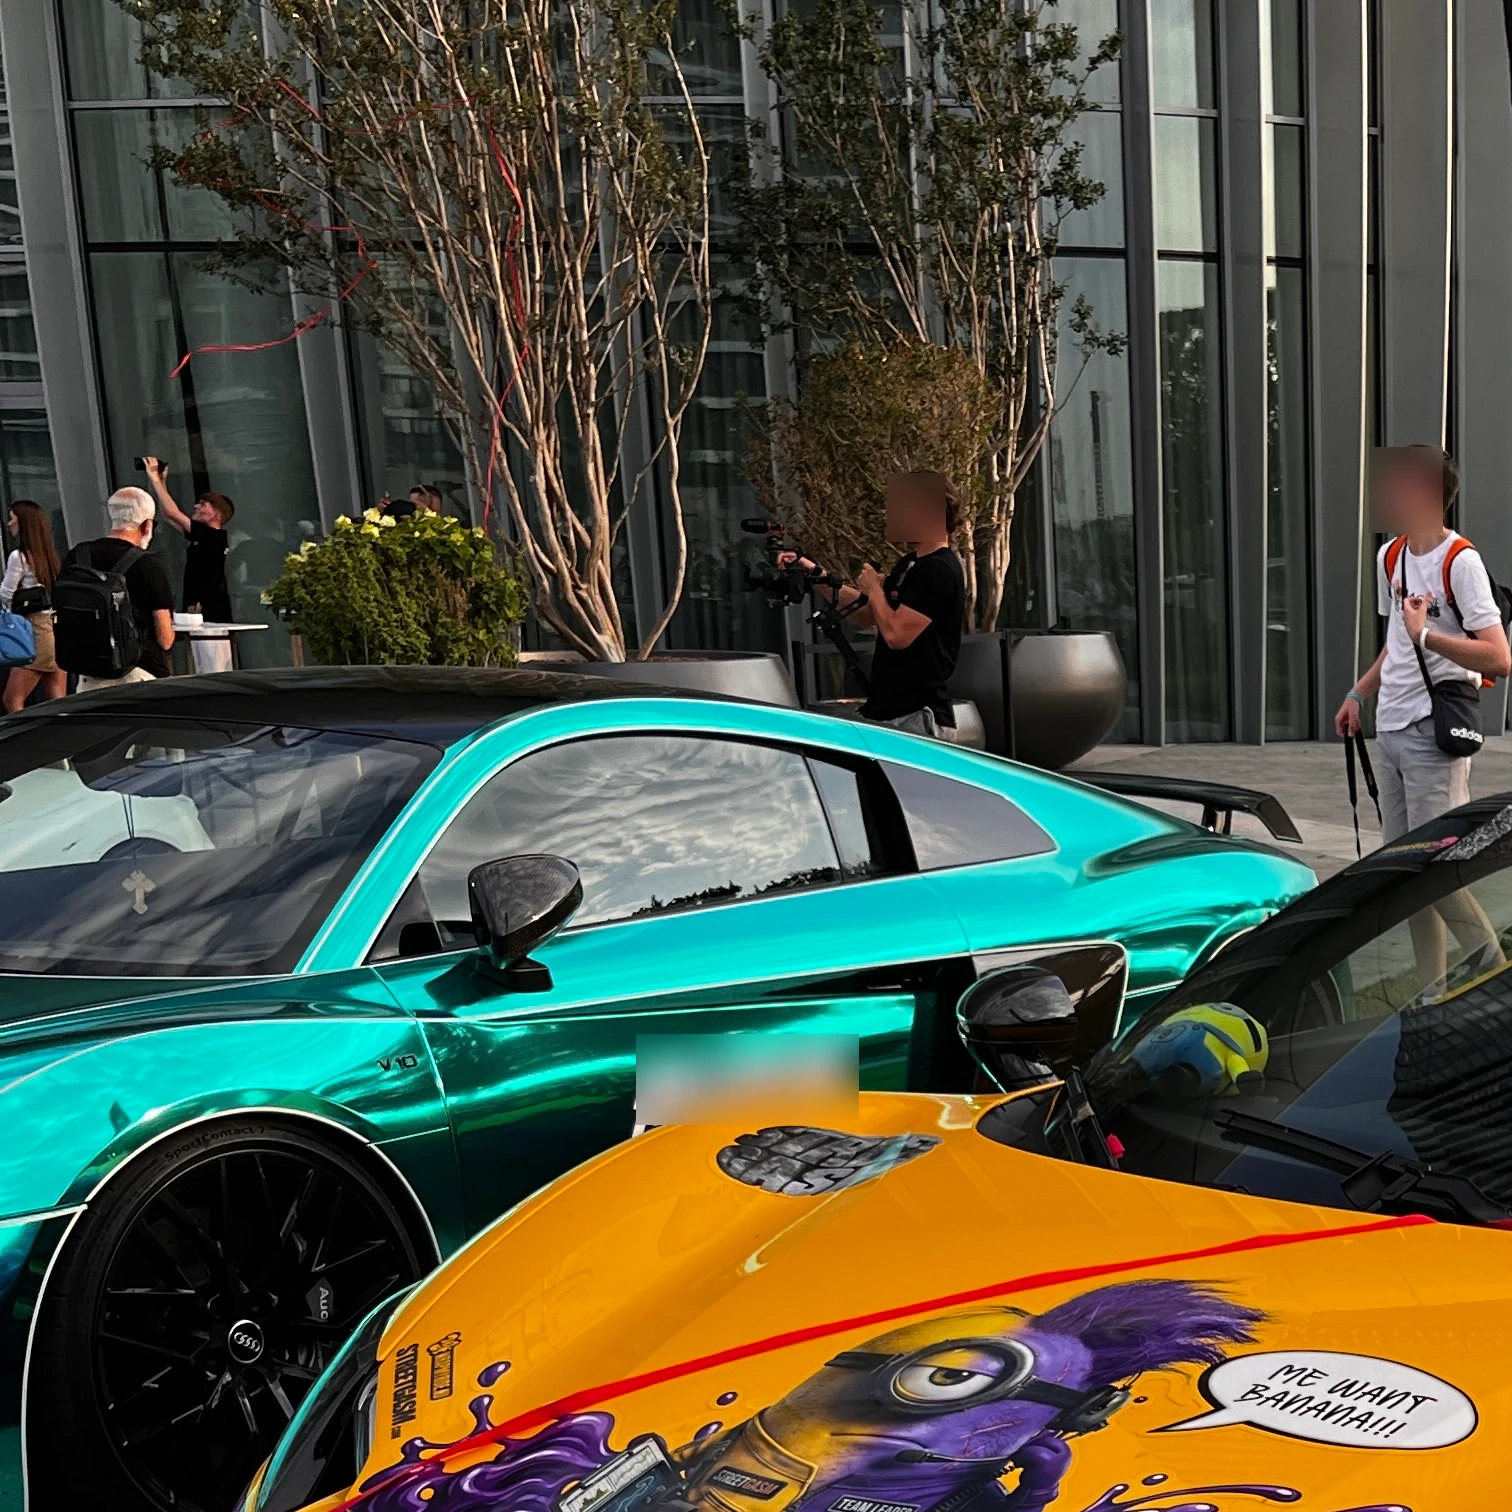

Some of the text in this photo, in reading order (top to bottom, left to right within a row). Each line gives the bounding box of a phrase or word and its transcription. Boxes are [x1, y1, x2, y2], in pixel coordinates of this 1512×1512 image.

[1450, 727, 1484, 743] adidas
[377, 1055, 419, 1071] V10
[164, 1126, 254, 1161] SportContact
[1268, 1364, 1438, 1414] ME WANT
[1233, 1383, 1408, 1439] BANANA!!!
[713, 1469, 780, 1495] STREETGASM
